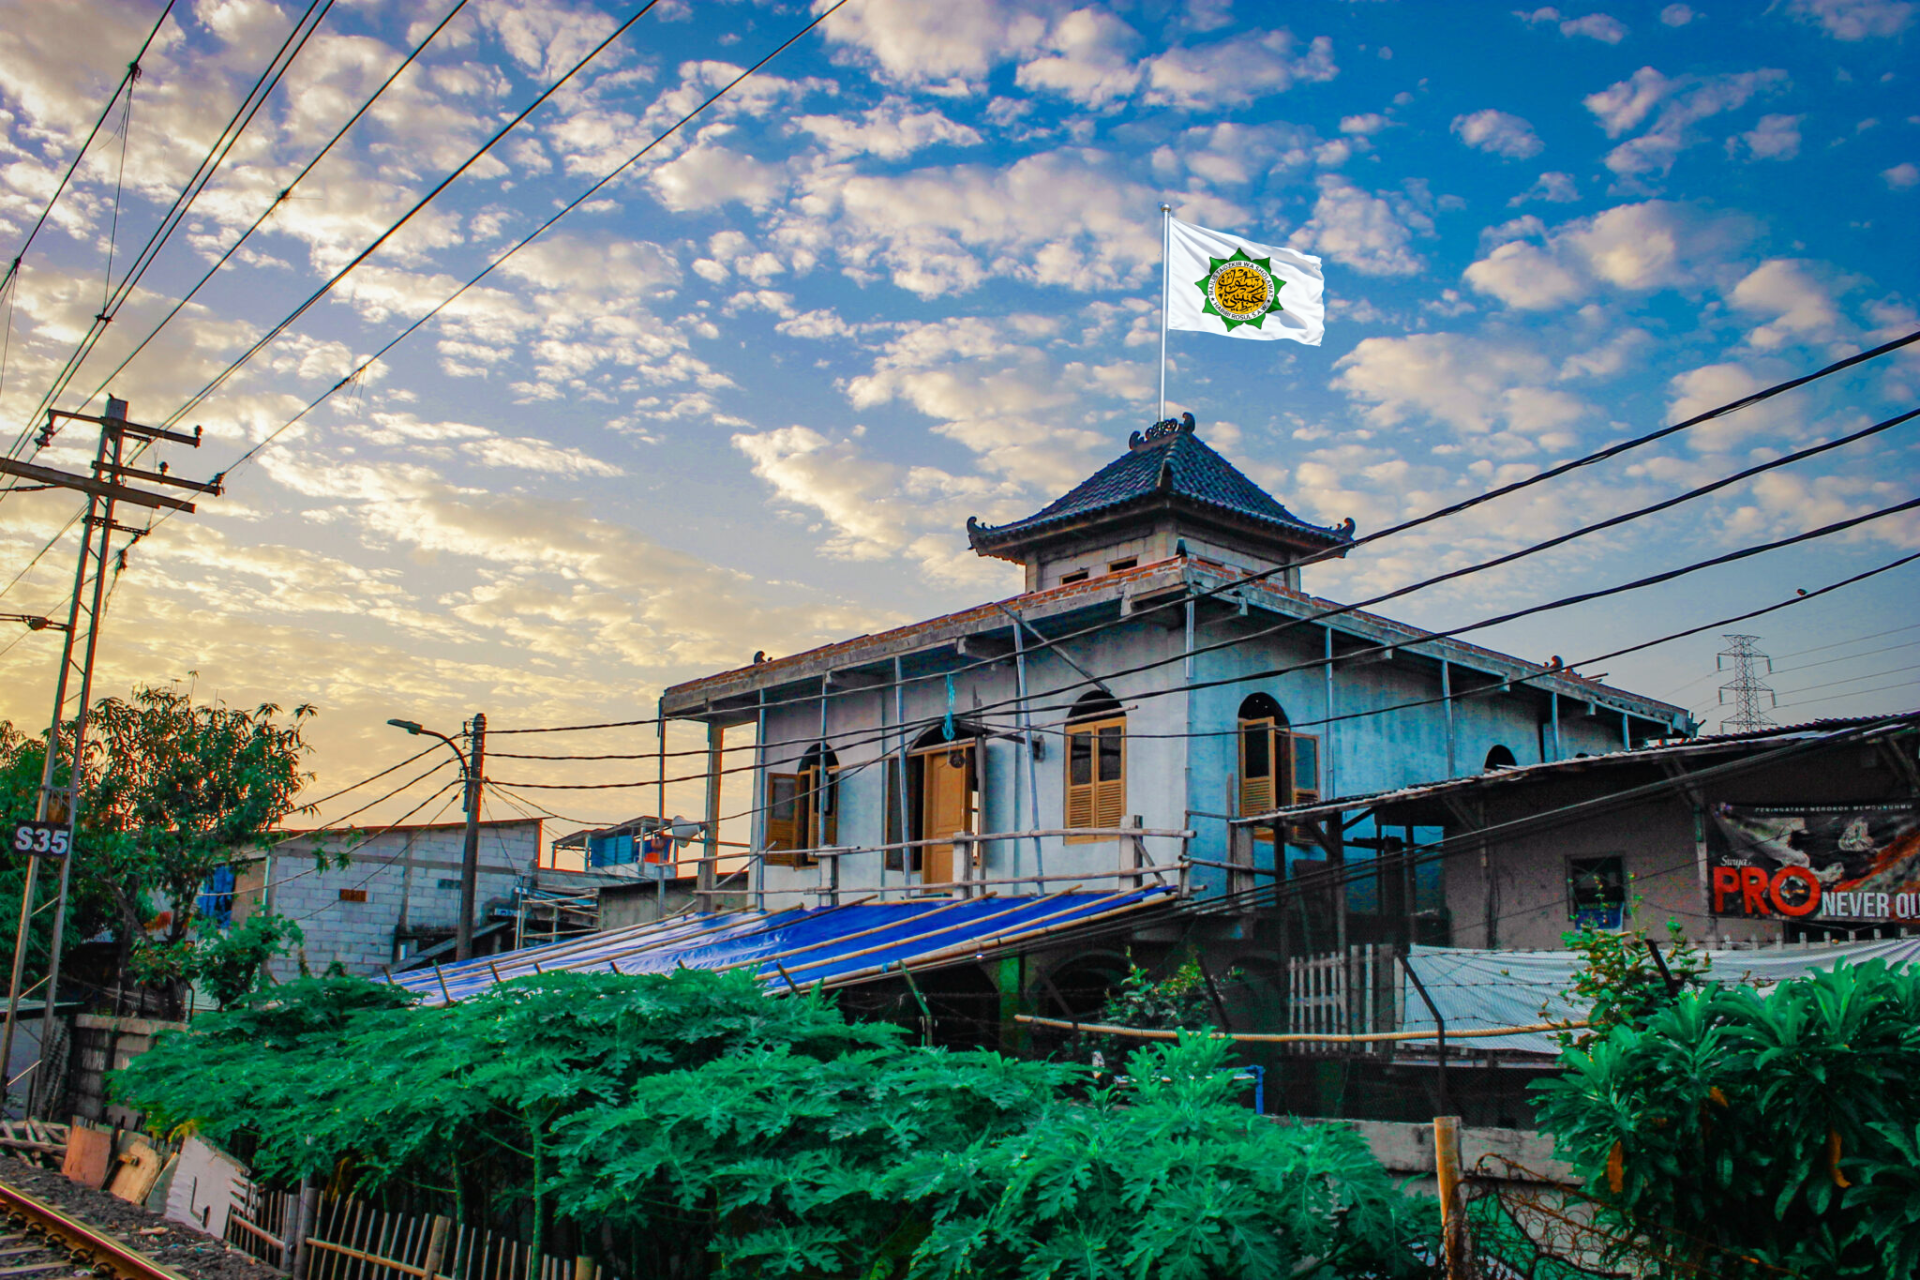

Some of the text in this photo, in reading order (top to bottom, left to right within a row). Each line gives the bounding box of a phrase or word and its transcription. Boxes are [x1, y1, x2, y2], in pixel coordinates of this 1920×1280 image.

[15, 826, 69, 854] S35
[1713, 865, 1821, 917] PRO
[1822, 891, 1890, 917] NEVER
